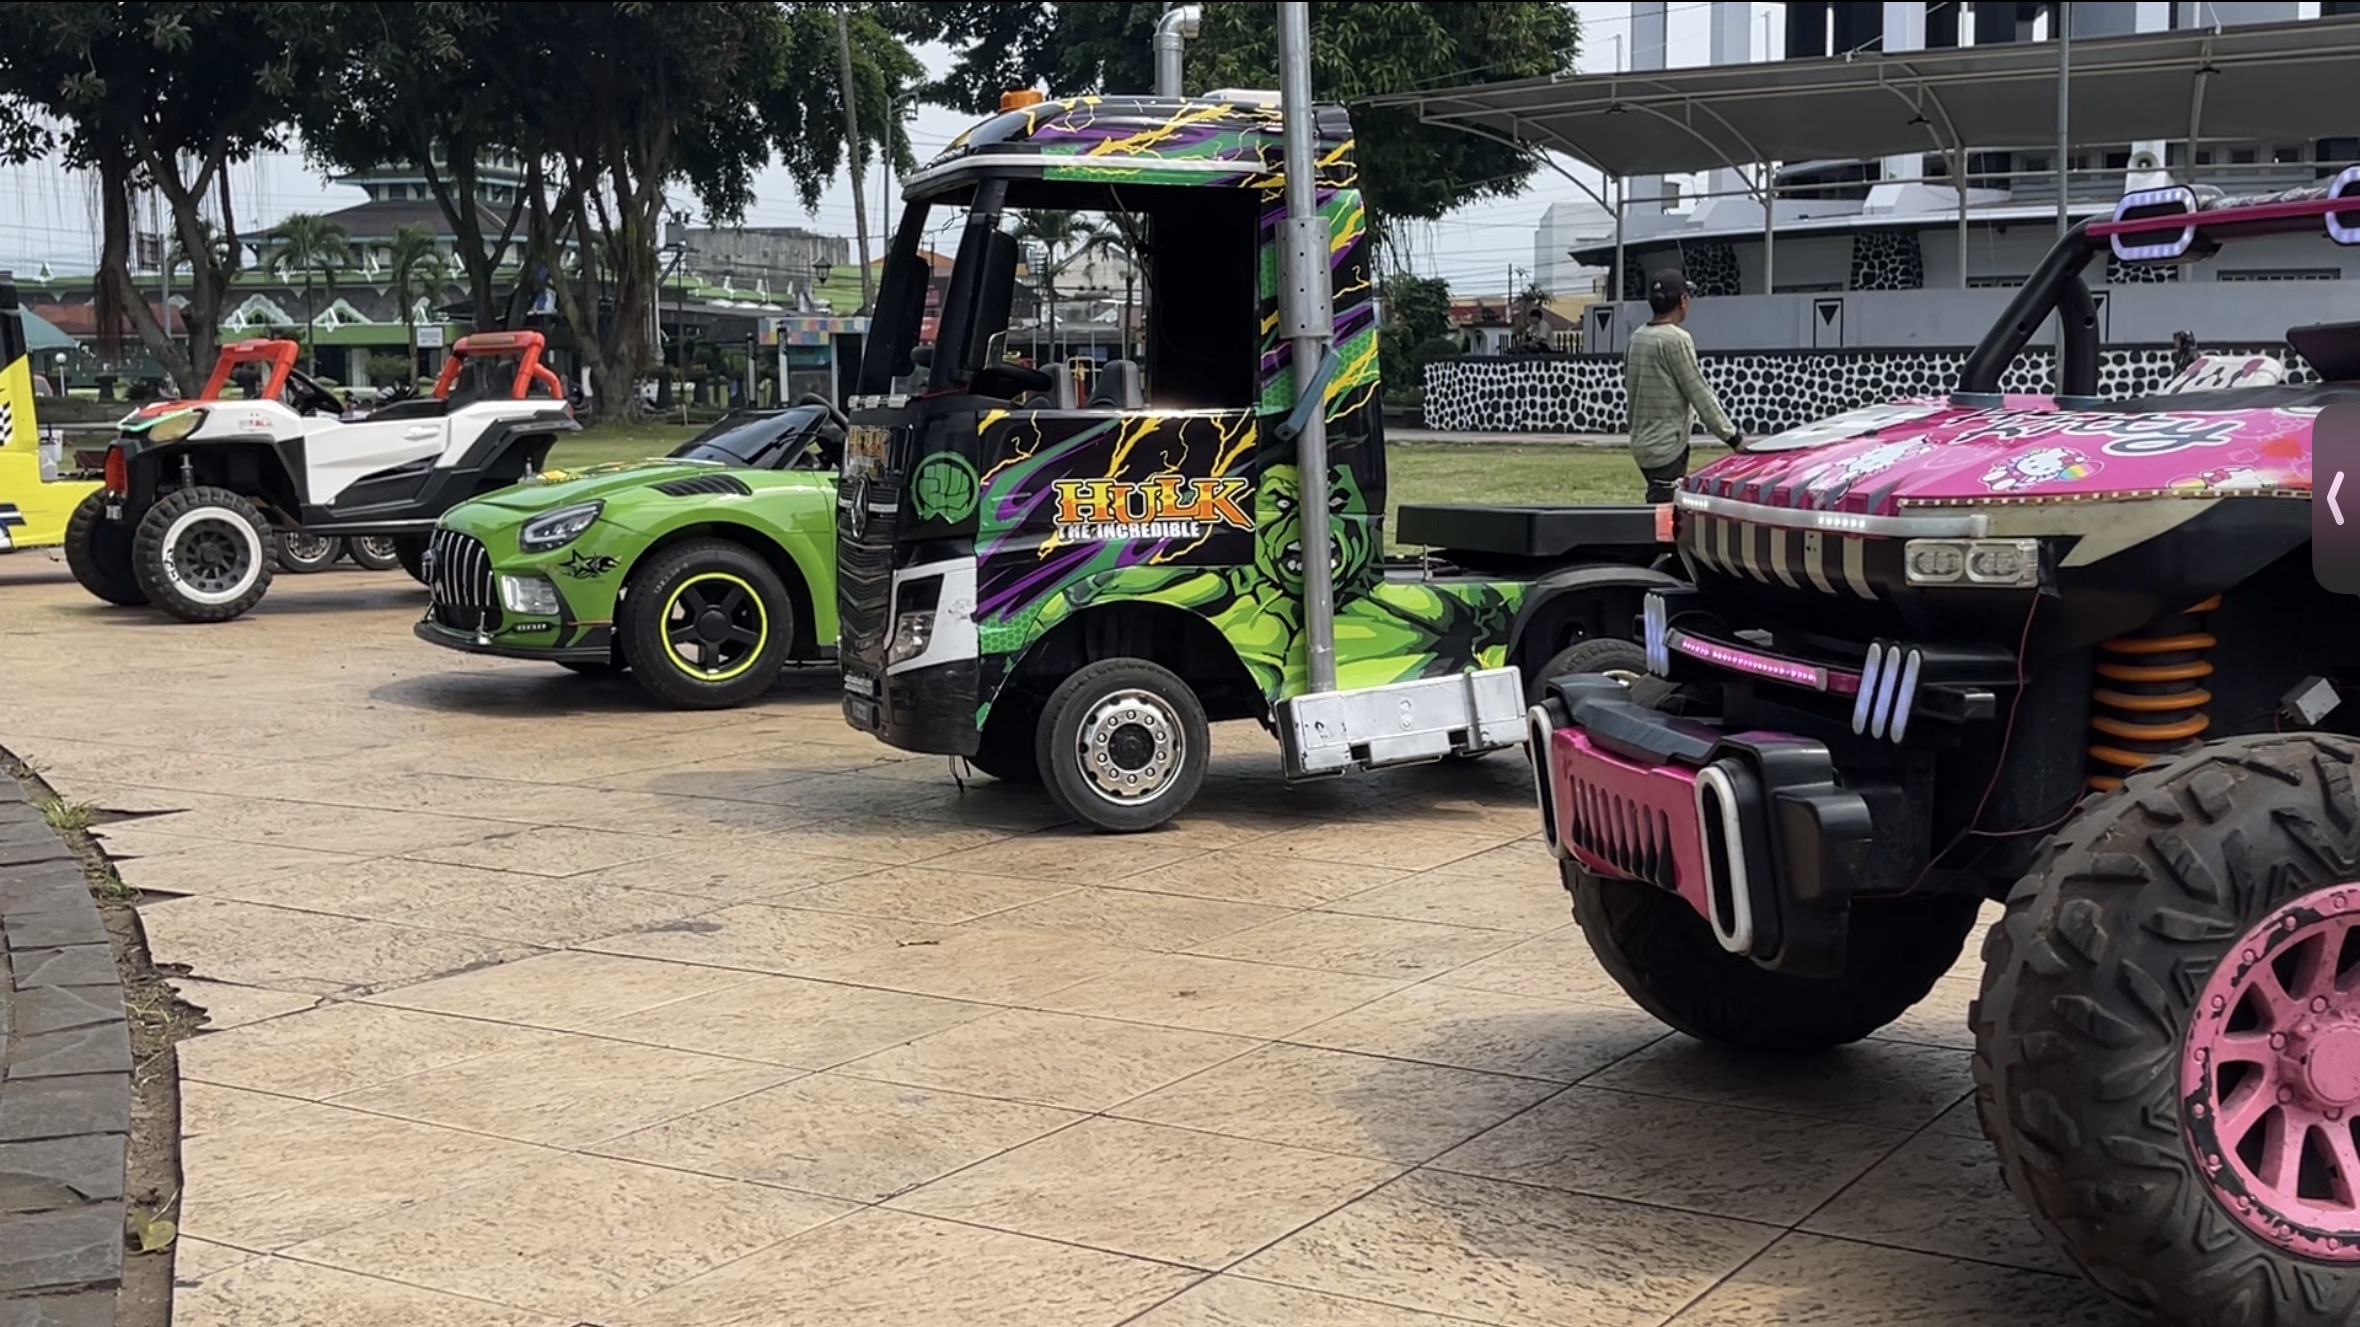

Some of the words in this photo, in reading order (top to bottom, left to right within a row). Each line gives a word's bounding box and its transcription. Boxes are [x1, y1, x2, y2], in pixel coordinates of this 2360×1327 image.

[1053, 474, 1255, 531] HULK
[1057, 523, 1091, 539] THE
[1097, 521, 1201, 538] INCREDIBLE
